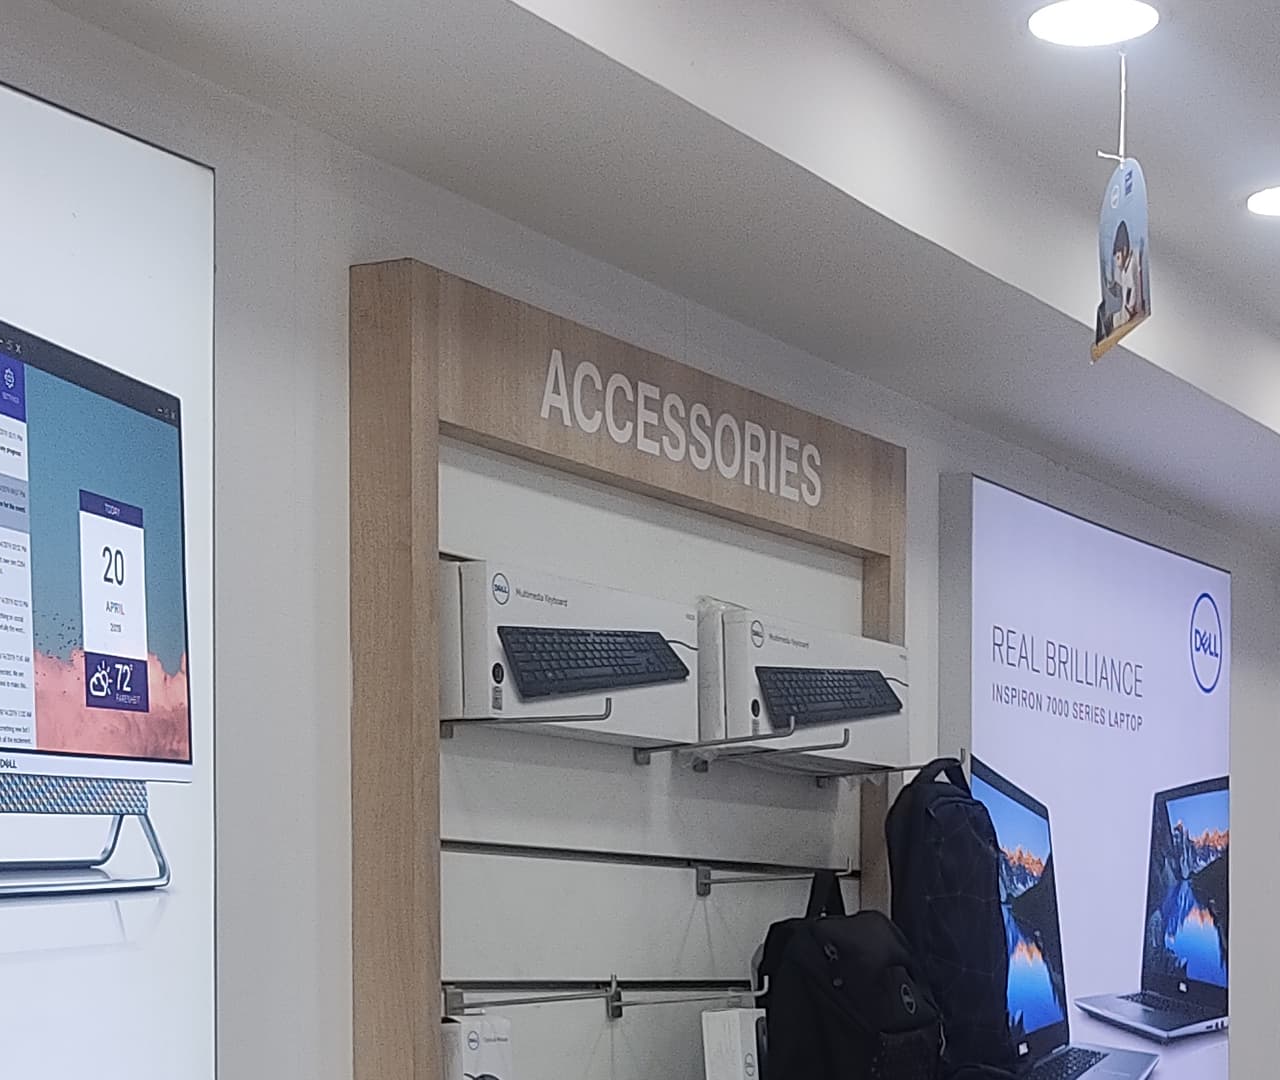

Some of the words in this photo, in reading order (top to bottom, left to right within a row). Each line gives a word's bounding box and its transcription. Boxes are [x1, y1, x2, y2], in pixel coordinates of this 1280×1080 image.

[540, 349, 821, 506] ACCESSORIES
[102, 545, 125, 586] 20
[494, 584, 509, 594] DELL
[105, 600, 126, 616] APRIL
[992, 625, 1041, 674] REAL
[1046, 640, 1144, 698] BRILLIANCE
[1194, 628, 1219, 659] DELL
[992, 683, 1043, 713] INSPIRON
[1046, 695, 1070, 718] 7000
[1072, 701, 1106, 726] SERIES
[1108, 712, 1144, 733] LAPTOP
[0, 758, 17, 770] DELL
